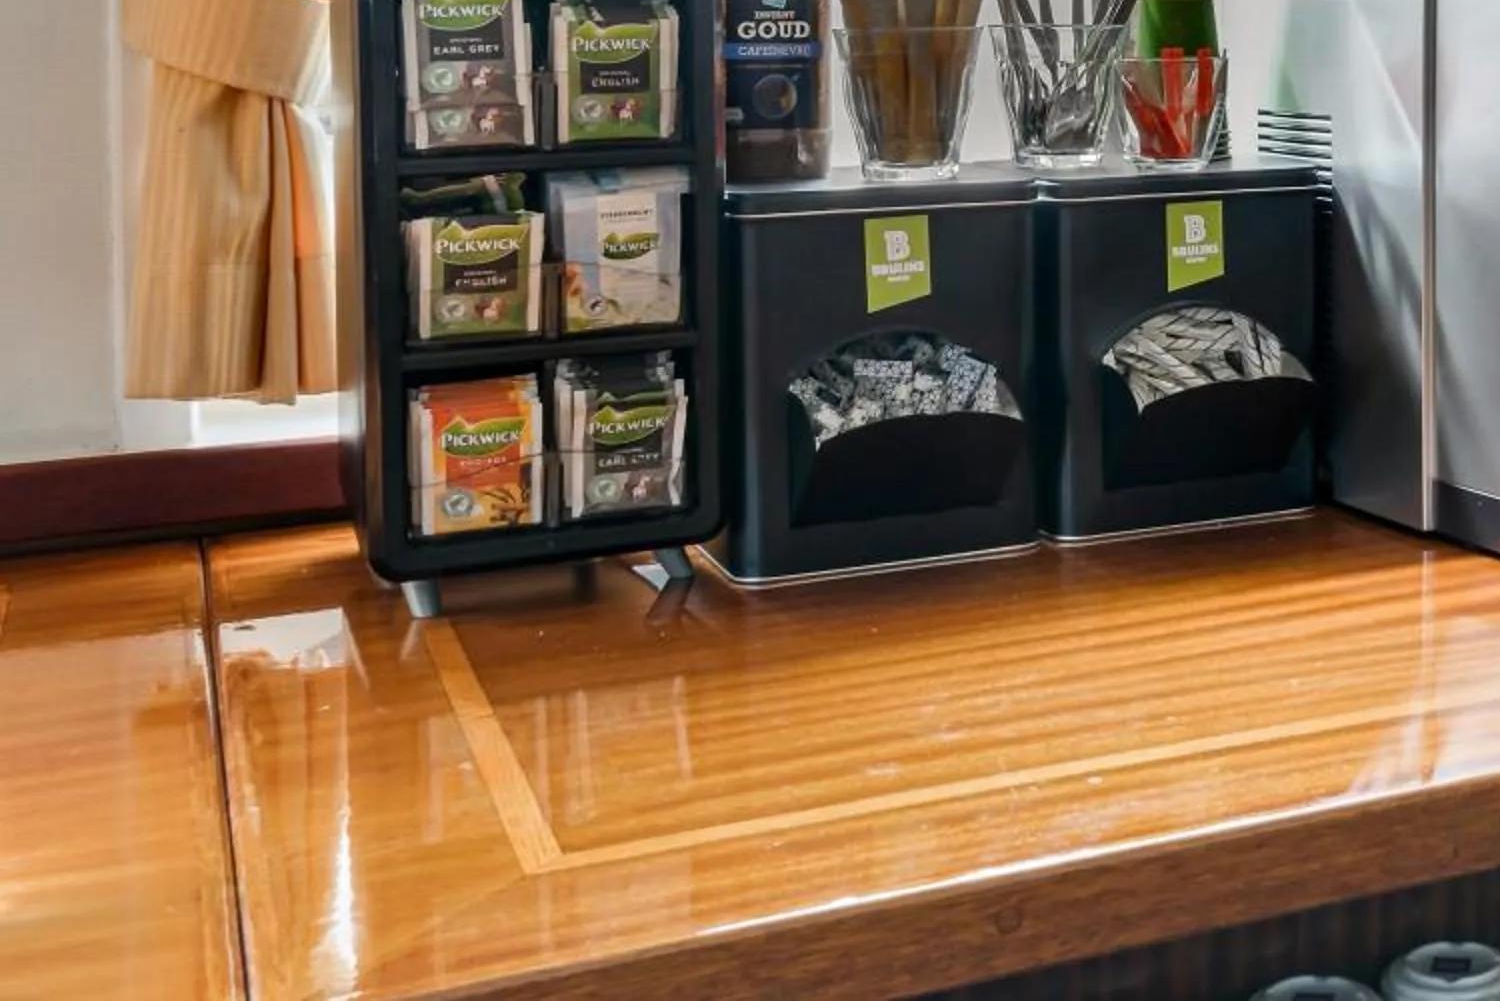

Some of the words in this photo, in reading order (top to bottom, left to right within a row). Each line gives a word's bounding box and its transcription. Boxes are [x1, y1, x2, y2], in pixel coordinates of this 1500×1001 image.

[419, 3, 503, 19] PICKWICK
[737, 21, 811, 39] GOUD
[572, 36, 650, 52] PICKWICK
[1184, 215, 1206, 243] B
[436, 238, 520, 254] PICKWICK
[884, 230, 910, 261] B
[589, 416, 668, 435] PICKWICK
[442, 430, 520, 448] PICKWICK
